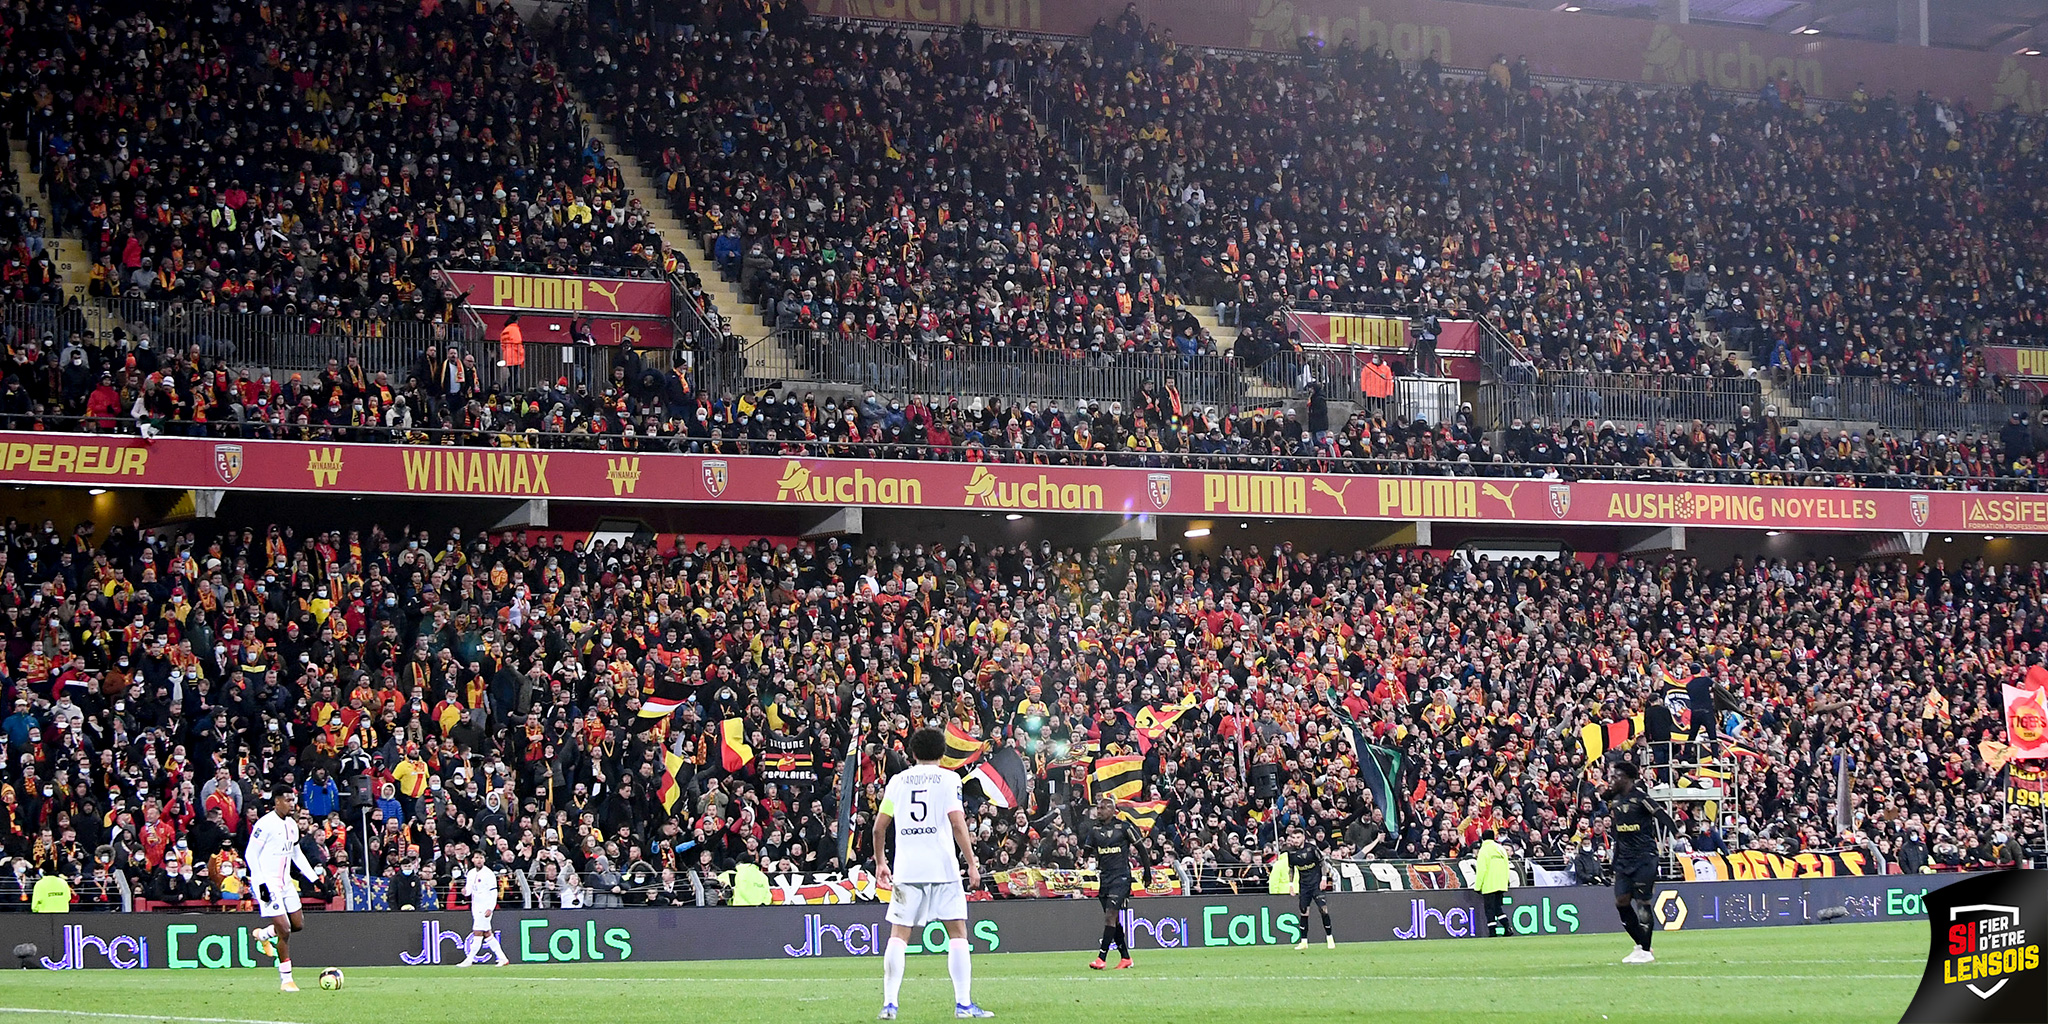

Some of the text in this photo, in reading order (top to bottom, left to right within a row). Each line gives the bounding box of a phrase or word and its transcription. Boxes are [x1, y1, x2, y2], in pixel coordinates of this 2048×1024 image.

[60, 263, 72, 271] 08
[493, 275, 584, 311] PUMA
[610, 321, 642, 343] 14
[1329, 316, 1404, 347] PUMA
[311, 461, 341, 472] WINAMAX
[402, 450, 550, 494] WINAMAX
[610, 470, 638, 480] WINAMAX
[776, 460, 922, 505] Auchan
[963, 466, 1103, 510] Auchan
[1203, 474, 1307, 514] PUMA
[1378, 479, 1477, 518] PUMA
[1608, 491, 1877, 521] AUSHOPPING NOYELLES
[2009, 715, 2047, 729] TIGERS
[910, 789, 928, 823] 5
[1615, 823, 1640, 833] uchan
